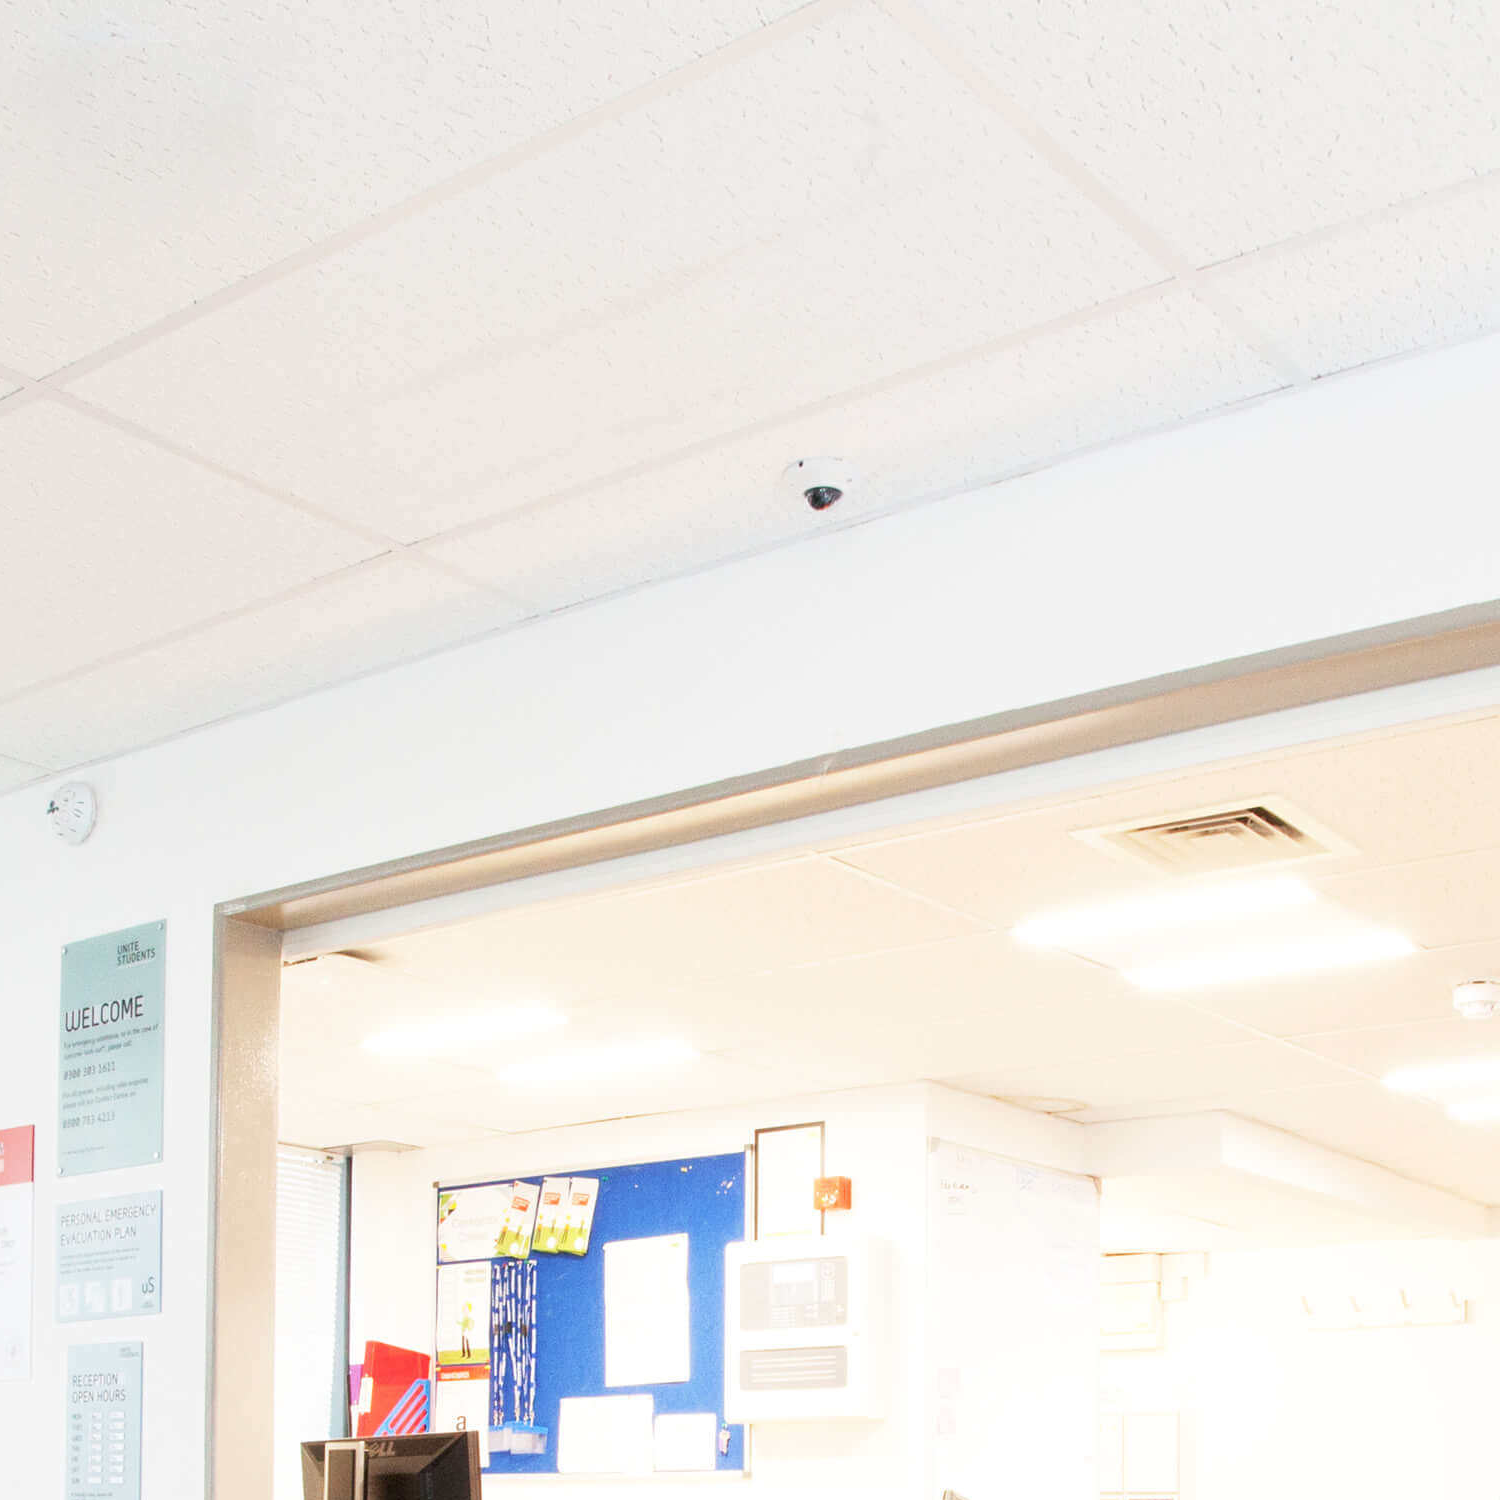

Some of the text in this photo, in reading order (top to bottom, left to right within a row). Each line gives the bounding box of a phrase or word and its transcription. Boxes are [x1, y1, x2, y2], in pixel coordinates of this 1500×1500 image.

[117, 940, 140, 955] UNITE
[117, 947, 156, 966] STUDENTS
[65, 995, 144, 1032] WELCOME
[60, 1200, 156, 1227] PERSONAL EMERGENCY
[60, 1224, 137, 1247] EVACUATION PLAN
[72, 1373, 118, 1387] RECEPTION
[72, 1388, 126, 1403] OPEN HOURS
